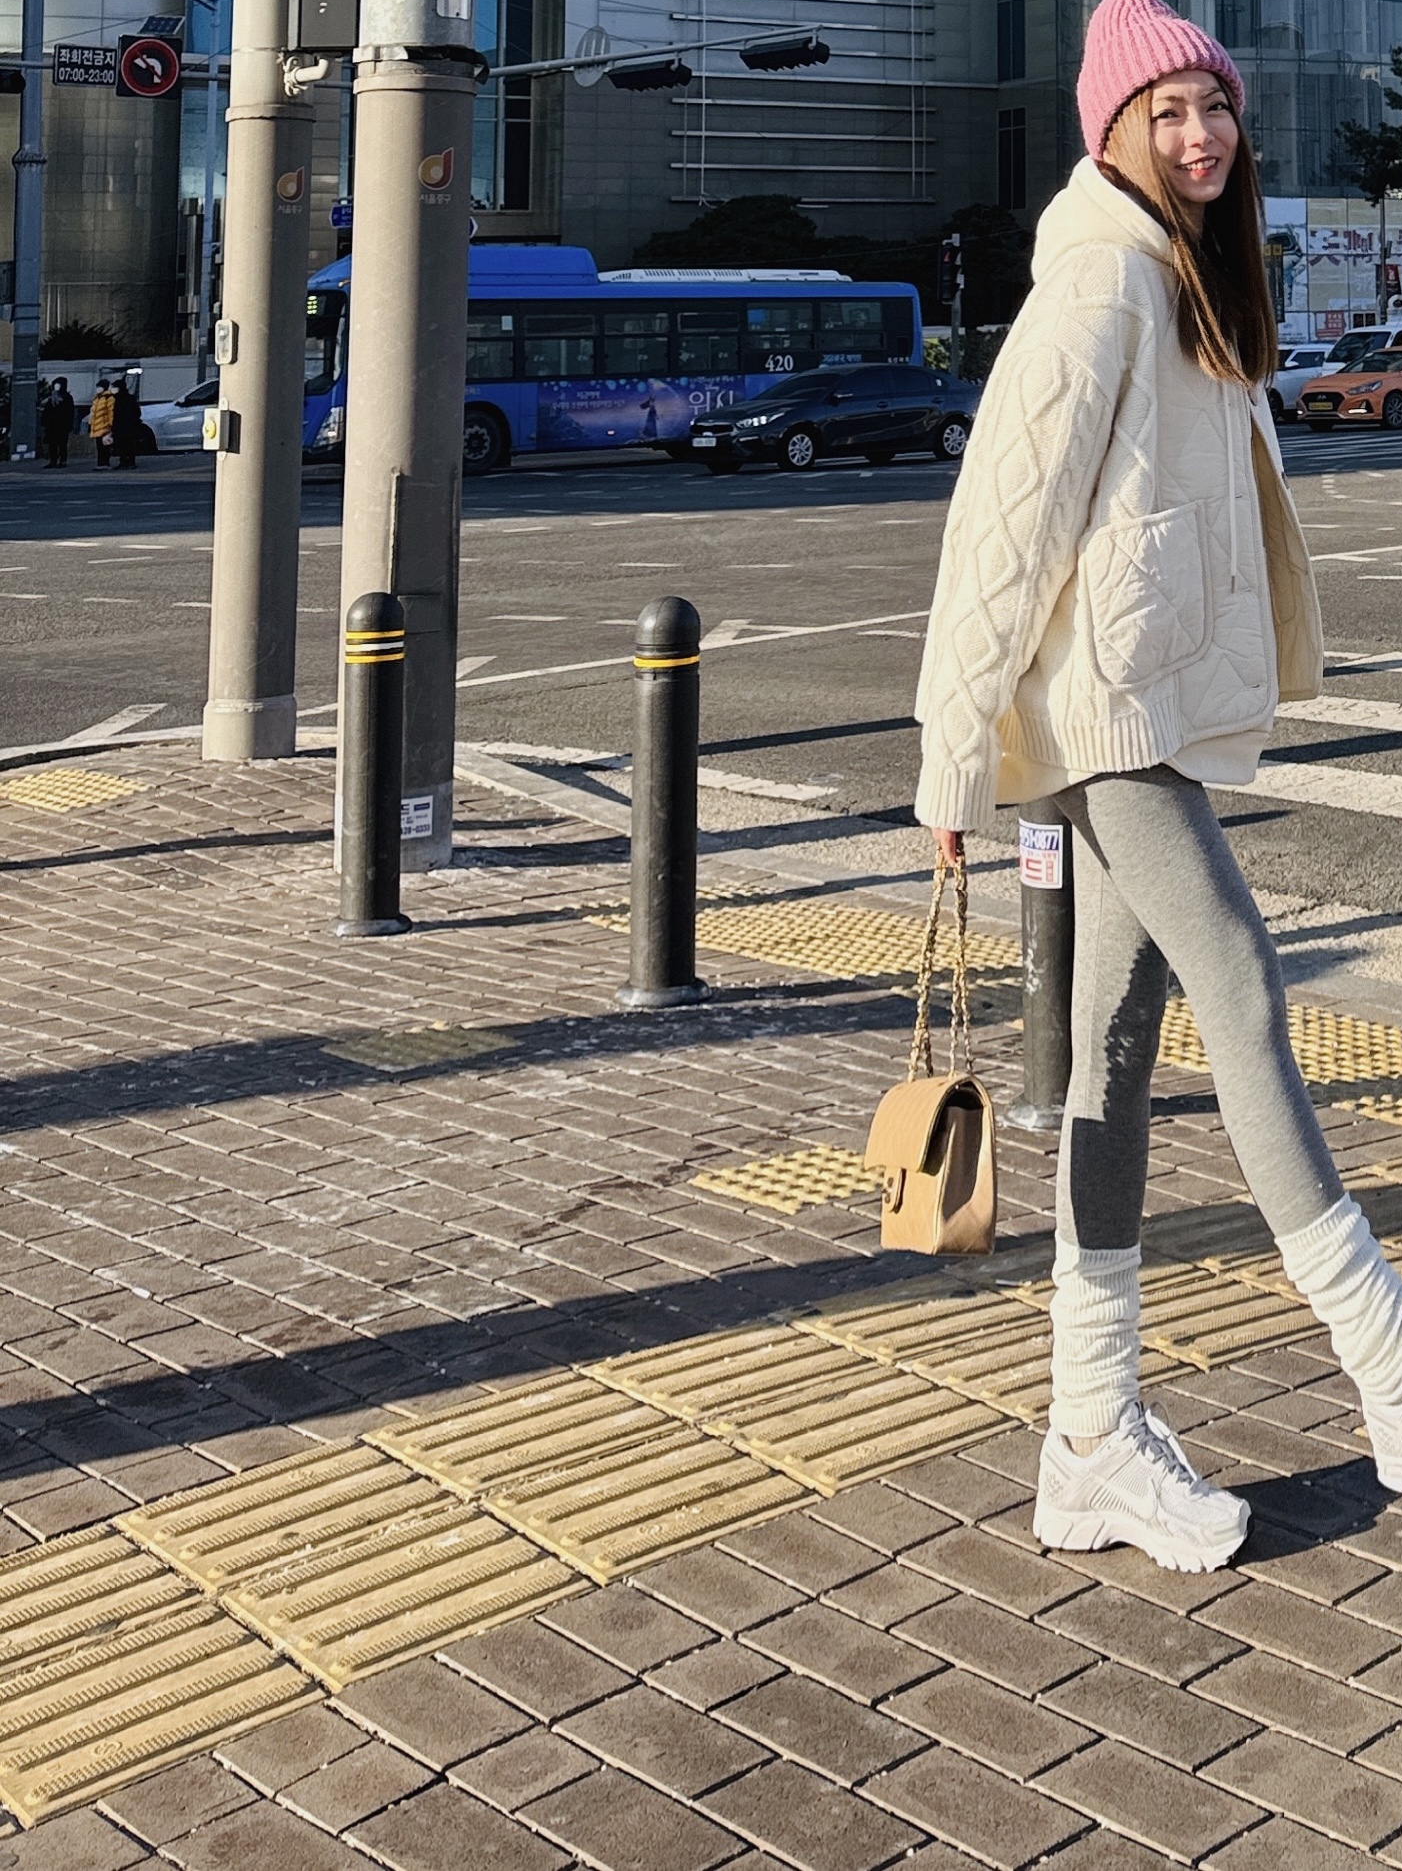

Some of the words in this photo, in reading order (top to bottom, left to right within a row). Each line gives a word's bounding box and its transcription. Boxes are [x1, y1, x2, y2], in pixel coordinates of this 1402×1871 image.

[59, 48, 115, 67] 좌회전금지
[59, 67, 115, 83] 07:00-23:00
[745, 355, 774, 372] 420
